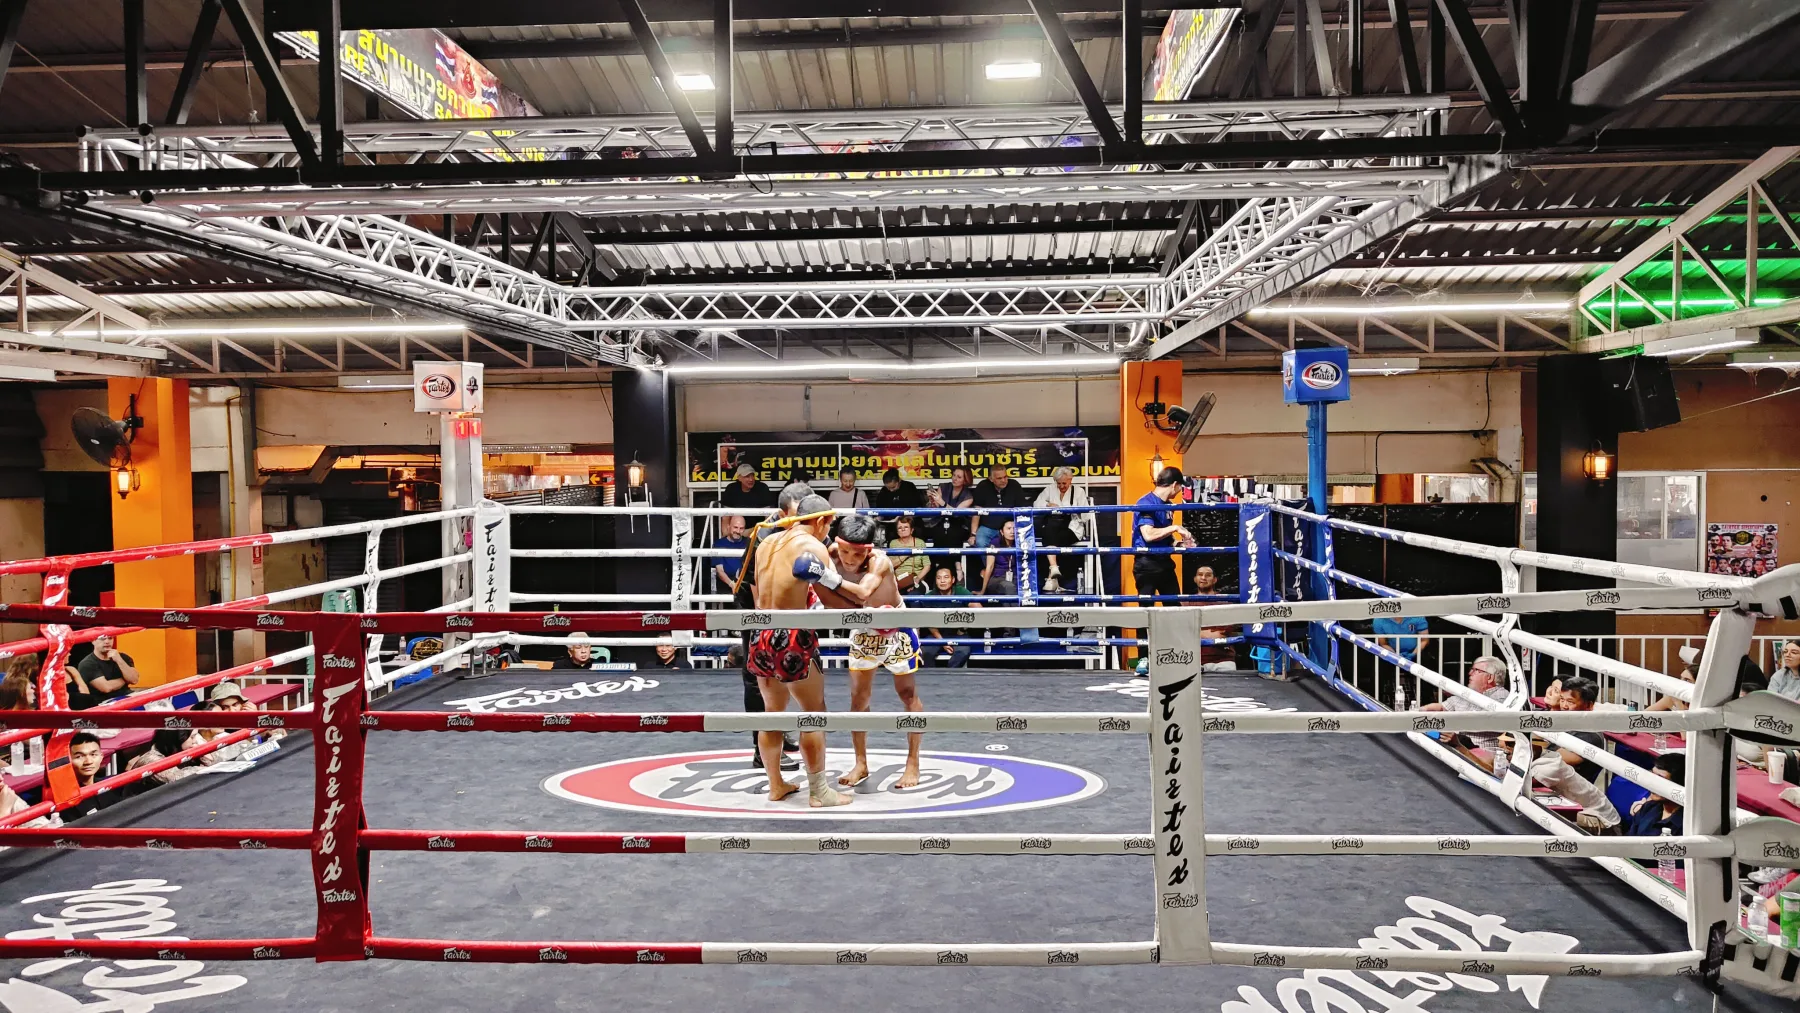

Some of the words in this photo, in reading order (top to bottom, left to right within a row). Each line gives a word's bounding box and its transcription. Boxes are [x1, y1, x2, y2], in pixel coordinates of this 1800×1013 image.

[458, 422, 466, 435] 1
[471, 421, 479, 434] 1
[1245, 513, 1265, 633] Fairtx
[1587, 591, 1620, 605] Fairtex
[1696, 588, 1732, 601] Fairtex
[1369, 601, 1401, 615] Fairtex
[1477, 596, 1510, 610] Fairtex
[842, 612, 873, 625] Fairtex
[944, 612, 975, 624] Fairtex
[1047, 611, 1079, 624] Fairtex
[1259, 605, 1292, 619] Fairtex
[257, 613, 285, 626] Fairtex
[446, 614, 474, 627] Fairtex
[543, 614, 571, 627] Fairtex
[642, 613, 670, 627] Fairtex
[741, 613, 772, 627] Fairtex
[322, 654, 356, 669] Fairtex
[1156, 648, 1194, 665] Fairtex
[257, 714, 284, 727] Fairtex
[447, 714, 475, 727] Fairtex
[543, 713, 571, 726] Fairtex
[639, 715, 668, 727] Fairtex
[797, 715, 827, 728] Fairtex
[897, 715, 927, 729] Fairtex
[997, 716, 1027, 730] Fairtex
[1099, 717, 1130, 731] Fairtex
[1203, 717, 1235, 731] Fairtex
[1308, 717, 1340, 731] Fairtex
[1413, 716, 1445, 730] Fairtex
[1520, 715, 1552, 729] Fairtex
[1629, 714, 1662, 729] Fairtex
[1755, 714, 1793, 734] Fairtex
[320, 678, 359, 884] Fairtex
[1158, 673, 1197, 886] Fairtex
[427, 836, 456, 850] Fairtex
[525, 835, 553, 849] Fairtex
[622, 837, 651, 849] Fairtex
[720, 837, 750, 850] Fairtex
[818, 837, 849, 851] Fairtex
[919, 837, 950, 851] Fairtex
[1020, 837, 1051, 850] Fairtex
[1124, 837, 1155, 850] Fairtex
[1227, 837, 1259, 850] Fairtex
[1332, 837, 1363, 849] Fairtex
[1437, 837, 1470, 850] Fairtex
[1544, 839, 1578, 853] Fairtex
[1653, 842, 1686, 857] Fairtex
[1763, 842, 1799, 859] Fairtex
[322, 890, 356, 903] Fairtex
[1162, 893, 1198, 909] Fairtex
[252, 946, 281, 959] Fairtex
[443, 947, 471, 961] Fairtex
[539, 947, 567, 961] Fairtex
[636, 949, 665, 962] Fairtex
[737, 949, 767, 964] Fairtex
[836, 951, 867, 964] Fairtex
[937, 951, 968, 964] Fairtex
[1047, 950, 1079, 964] Fairtex
[1254, 952, 1285, 966] Fairtex
[1356, 956, 1388, 969] Fairtex
[1462, 960, 1494, 974] Fairtex
